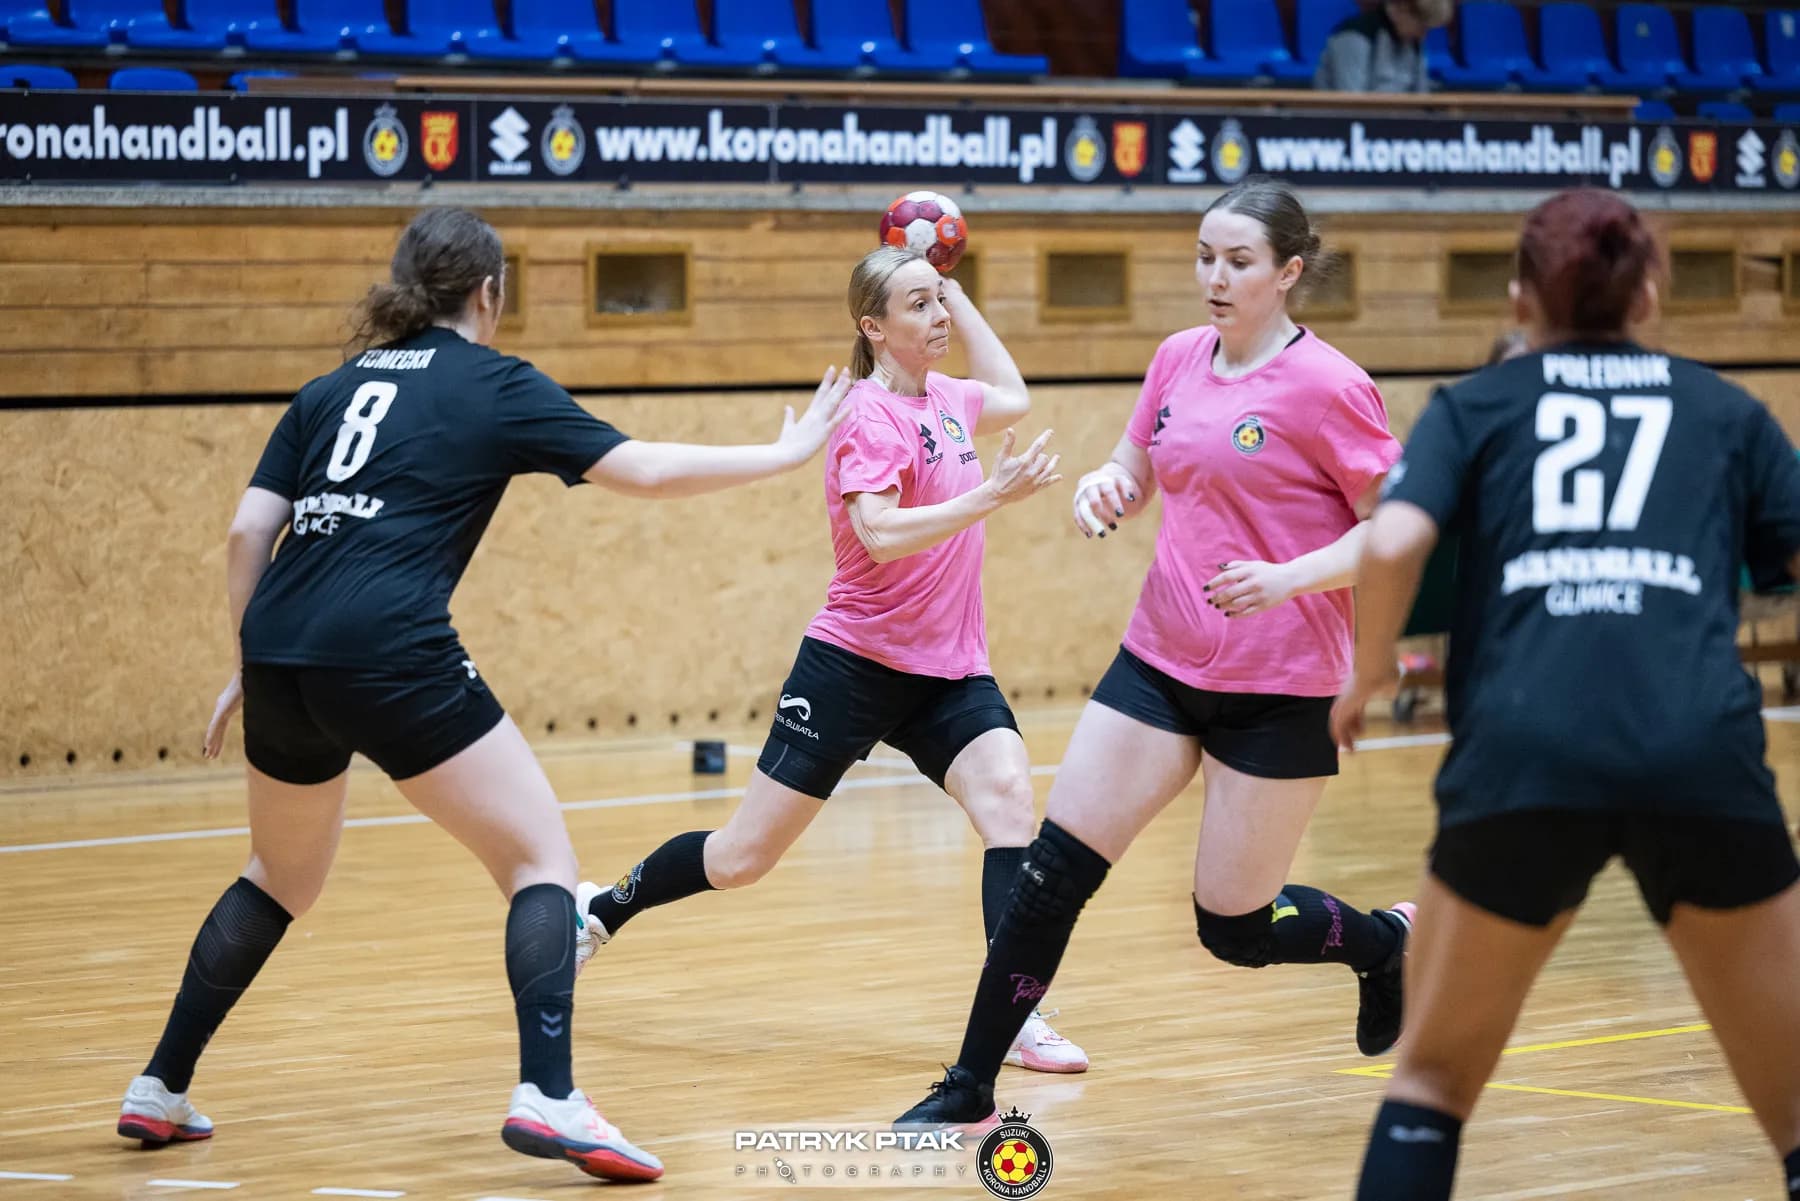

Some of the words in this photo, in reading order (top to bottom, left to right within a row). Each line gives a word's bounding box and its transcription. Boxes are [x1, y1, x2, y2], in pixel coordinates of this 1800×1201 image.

[596, 109, 1057, 182] www.koronahandball.pl
[1257, 123, 1641, 188] www.koronahandball.pl
[326, 380, 399, 483] 8
[1532, 391, 1673, 534] 27
